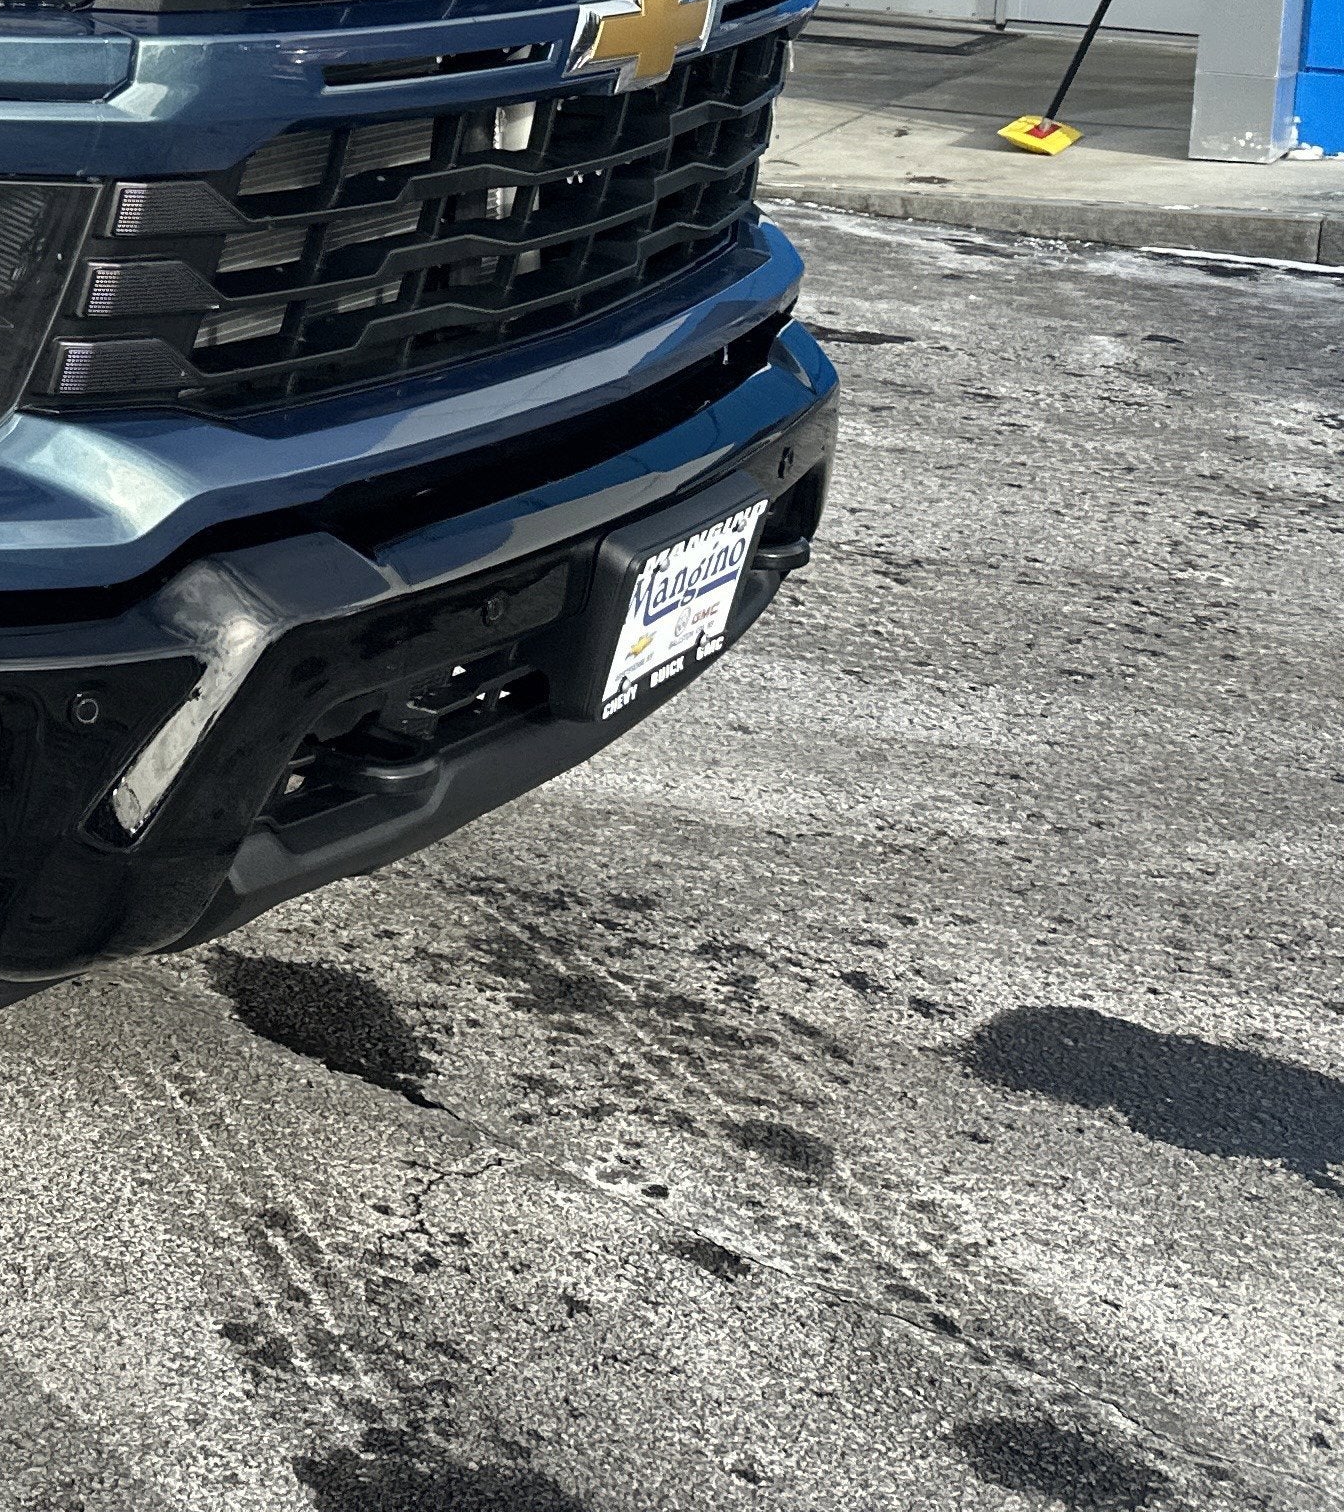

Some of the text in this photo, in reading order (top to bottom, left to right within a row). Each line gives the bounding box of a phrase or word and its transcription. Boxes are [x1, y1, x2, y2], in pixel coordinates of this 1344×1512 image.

[629, 537, 747, 619] Mangino
[691, 601, 720, 625] GMC
[602, 683, 638, 720] CHEVY
[649, 655, 685, 689] BUICK
[696, 635, 725, 661] GMC
